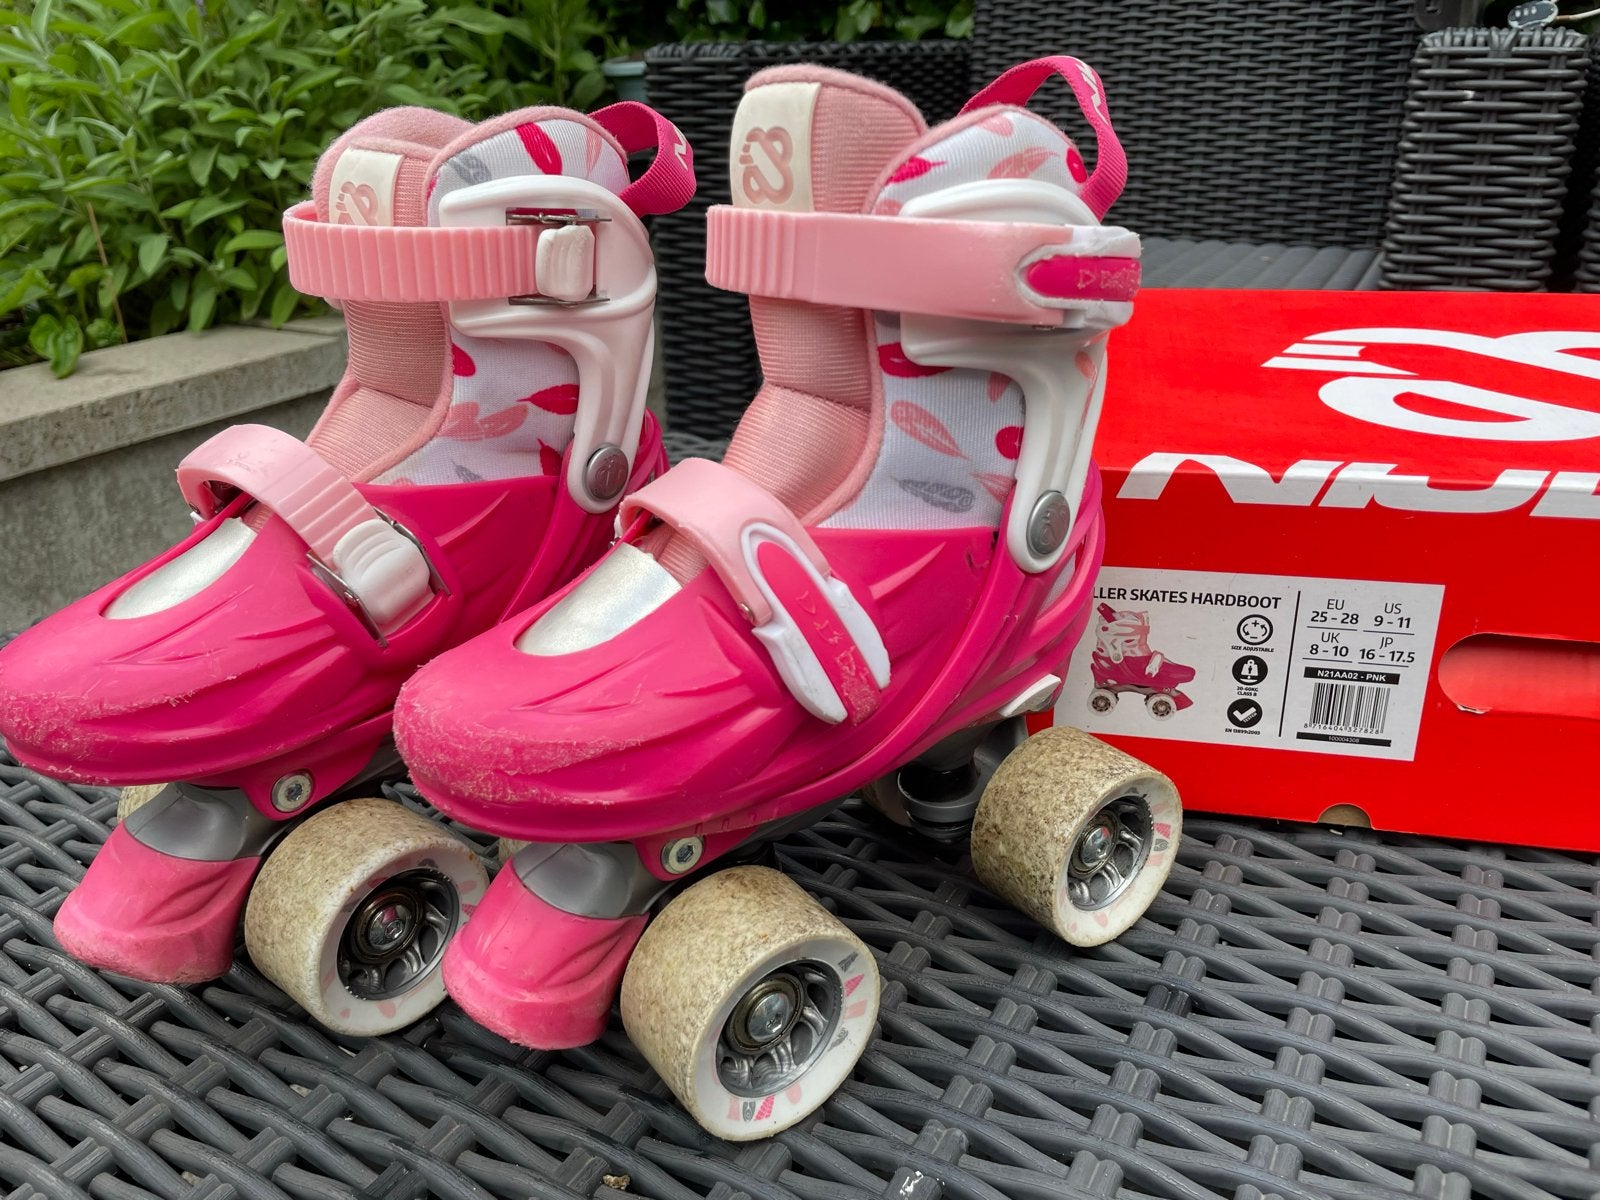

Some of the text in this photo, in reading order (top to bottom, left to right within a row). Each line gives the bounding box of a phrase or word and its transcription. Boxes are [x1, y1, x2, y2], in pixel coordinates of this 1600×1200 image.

[1115, 451, 1600, 519] NIJ
[1130, 588, 1188, 604] SKATES
[1191, 592, 1282, 609] HARDBOOT
[1327, 598, 1345, 610] EU
[1384, 602, 1402, 614] US
[1310, 610, 1328, 622] 25
[1340, 612, 1359, 625] 28
[1374, 615, 1383, 627] 9
[1397, 617, 1411, 629] 11
[1321, 632, 1340, 643] UK
[1379, 637, 1394, 649] JP
[1309, 644, 1319, 655] 8
[1332, 646, 1349, 657] 10
[1360, 649, 1375, 660] 16
[1389, 651, 1415, 663] 17.5
[1317, 670, 1359, 680] N21AA02
[1366, 674, 1387, 682] PNK
